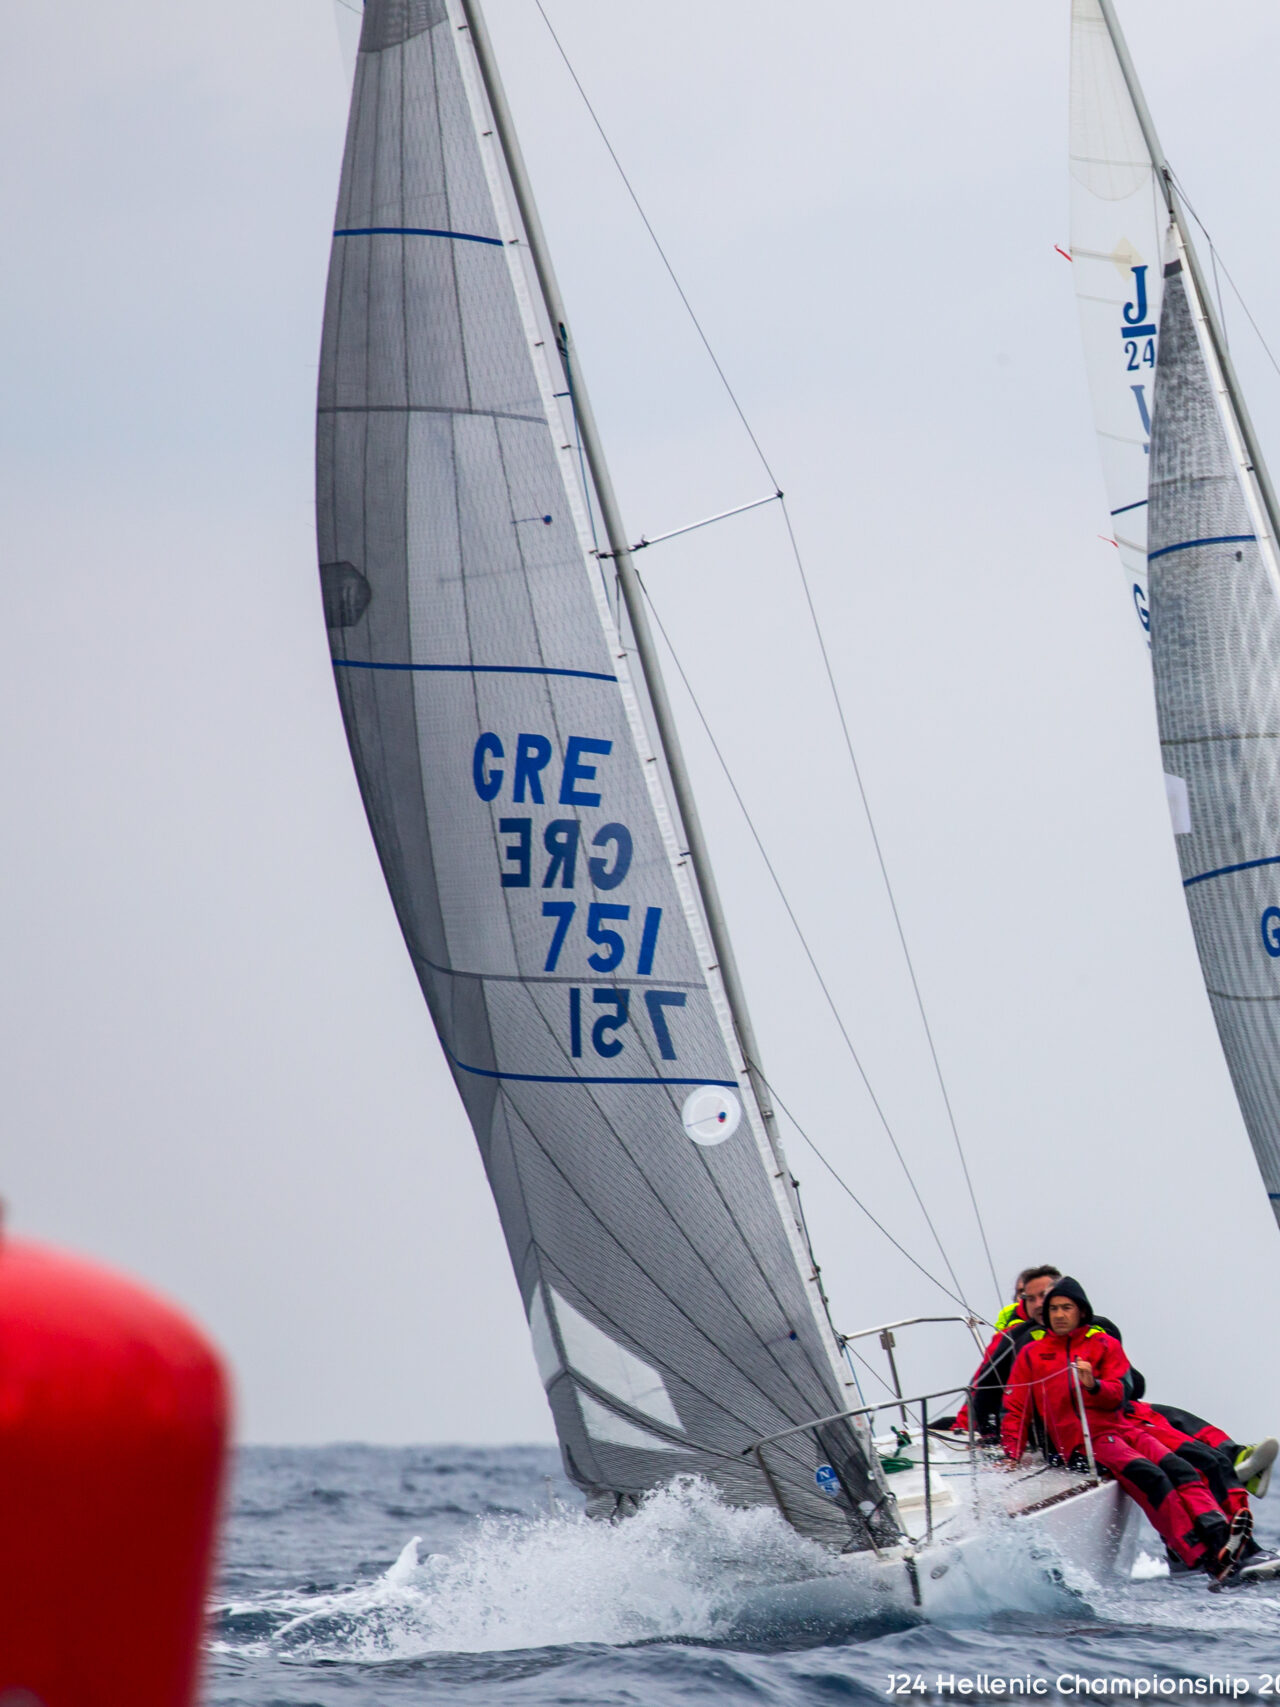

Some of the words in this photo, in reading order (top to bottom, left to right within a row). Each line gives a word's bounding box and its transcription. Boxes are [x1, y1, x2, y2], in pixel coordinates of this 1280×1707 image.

[1122, 265, 1149, 325] J
[1124, 338, 1156, 372] 24
[472, 731, 613, 808] GRE
[541, 901, 663, 976] 751
